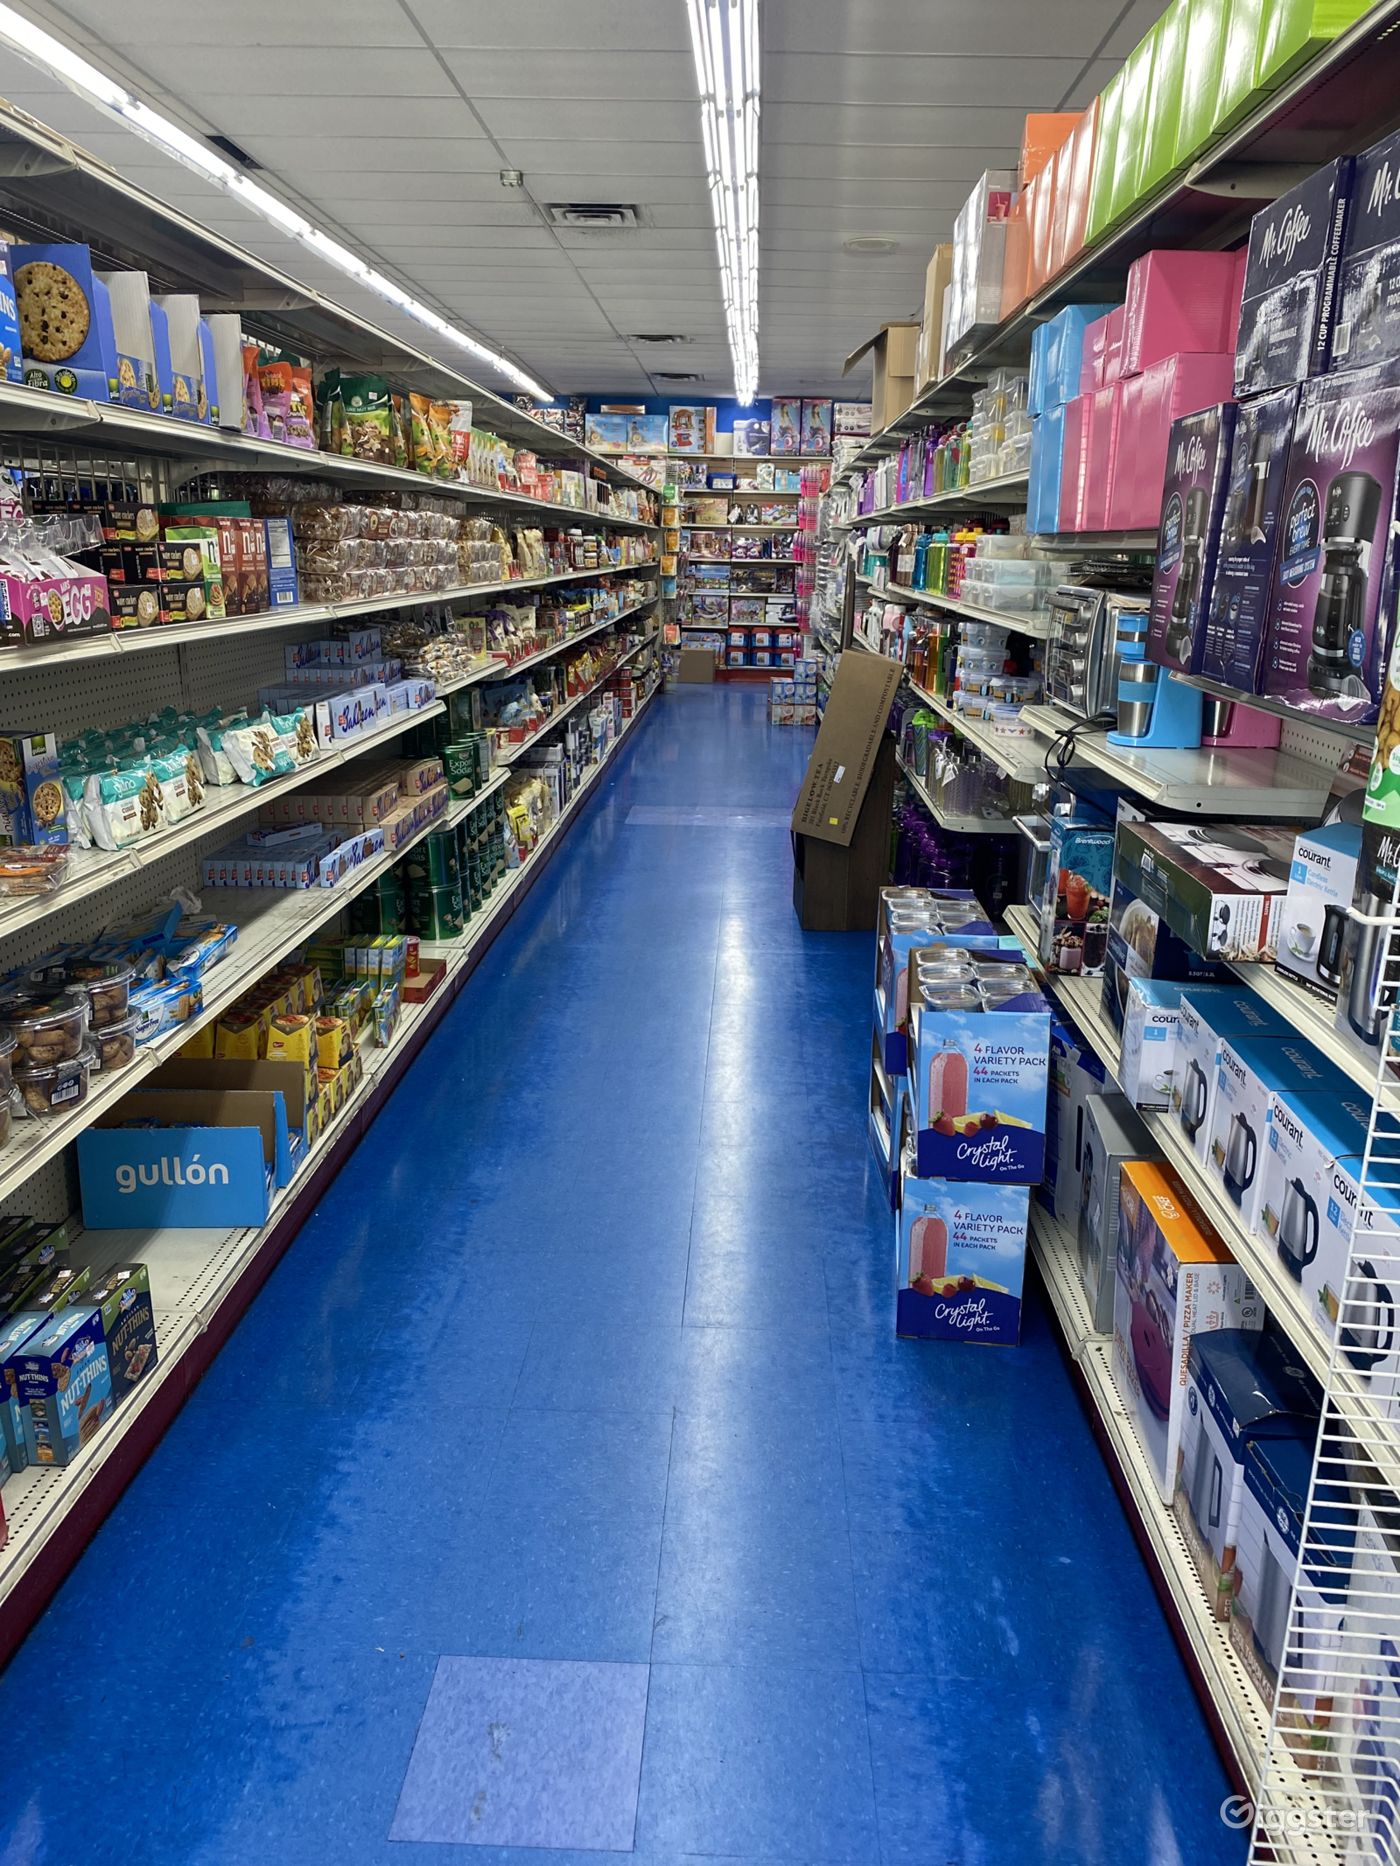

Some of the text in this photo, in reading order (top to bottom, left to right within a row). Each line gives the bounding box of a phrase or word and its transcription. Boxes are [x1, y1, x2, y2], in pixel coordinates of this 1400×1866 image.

[1367, 161, 1393, 216] Mr.
[1259, 204, 1311, 268] Mr. Coffee
[1317, 198, 1346, 351] 12 CUP PROGRAMMABLE COFFEEMAKER
[1305, 401, 1376, 470] Mr. Coffee
[1288, 499, 1316, 536] perfect
[1291, 522, 1311, 543] brew
[64, 584, 90, 626] EGG
[1075, 837, 1111, 845] Brentwood
[1298, 847, 1331, 869] courant
[1152, 1014, 1181, 1024] cour
[974, 1043, 1025, 1056] 4 FLAVOR
[974, 1056, 1046, 1067] VARIETY PACK
[973, 1066, 988, 1076] 44
[1222, 1049, 1247, 1086] courant
[1273, 1104, 1304, 1149] courant
[956, 1135, 1009, 1166] Crystal
[115, 1154, 229, 1194] gullón
[1333, 1174, 1373, 1227] cournt
[954, 1210, 1003, 1224] 4 FLAVOR
[954, 1222, 1024, 1236] VARIETY PACK
[953, 1232, 967, 1241] 44
[1185, 1272, 1194, 1302] MAKER
[935, 1298, 986, 1326] Crystal
[1183, 1304, 1192, 1328] PIZZA
[112, 1306, 149, 1356] NUT-THINS
[1179, 1335, 1190, 1387] QUESADILLA
[61, 1354, 107, 1417] NUT-THINS
